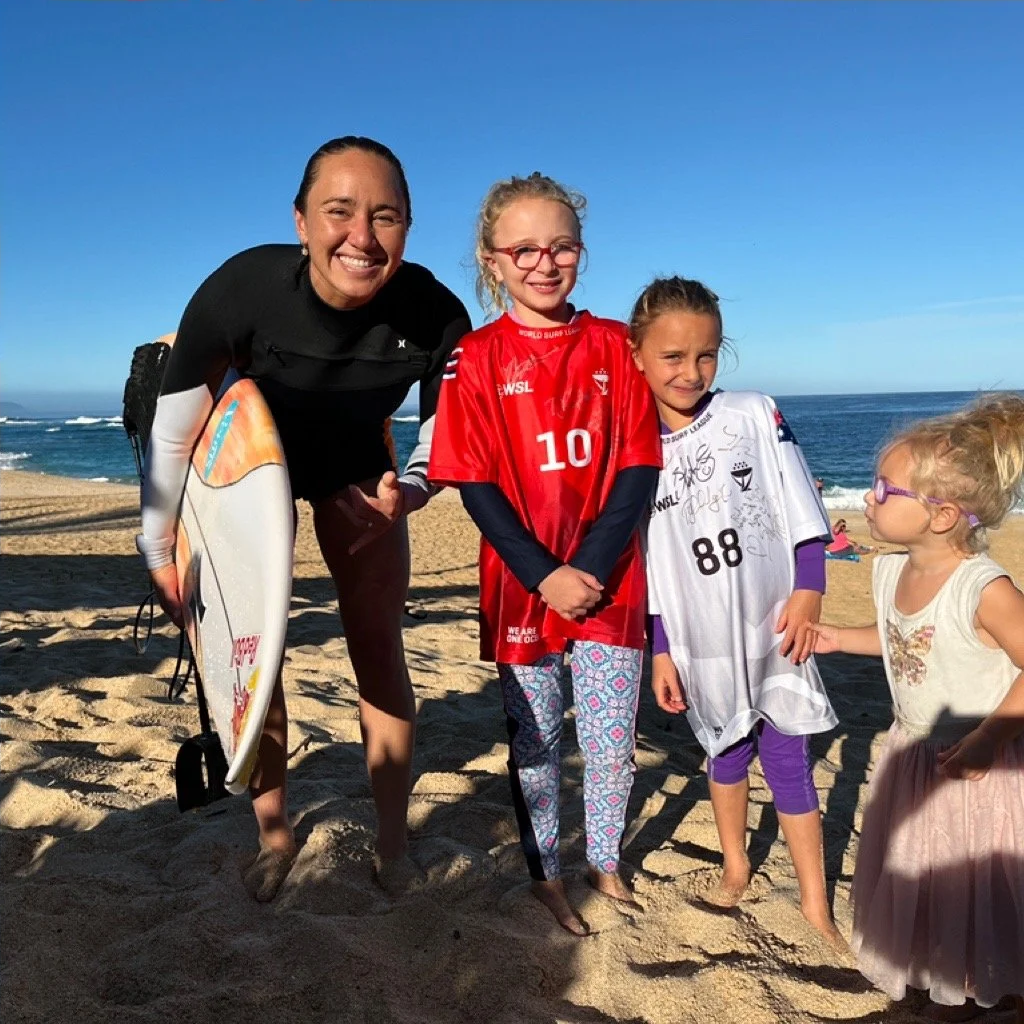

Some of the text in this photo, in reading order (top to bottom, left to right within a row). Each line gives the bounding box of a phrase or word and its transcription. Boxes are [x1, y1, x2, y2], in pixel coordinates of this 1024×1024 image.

[503, 381, 534, 396] WSL
[537, 428, 592, 472] 10
[654, 494, 679, 512] WSL
[691, 527, 743, 576] 88
[507, 626, 537, 635] WE ARE
[506, 635, 522, 644] ONE
